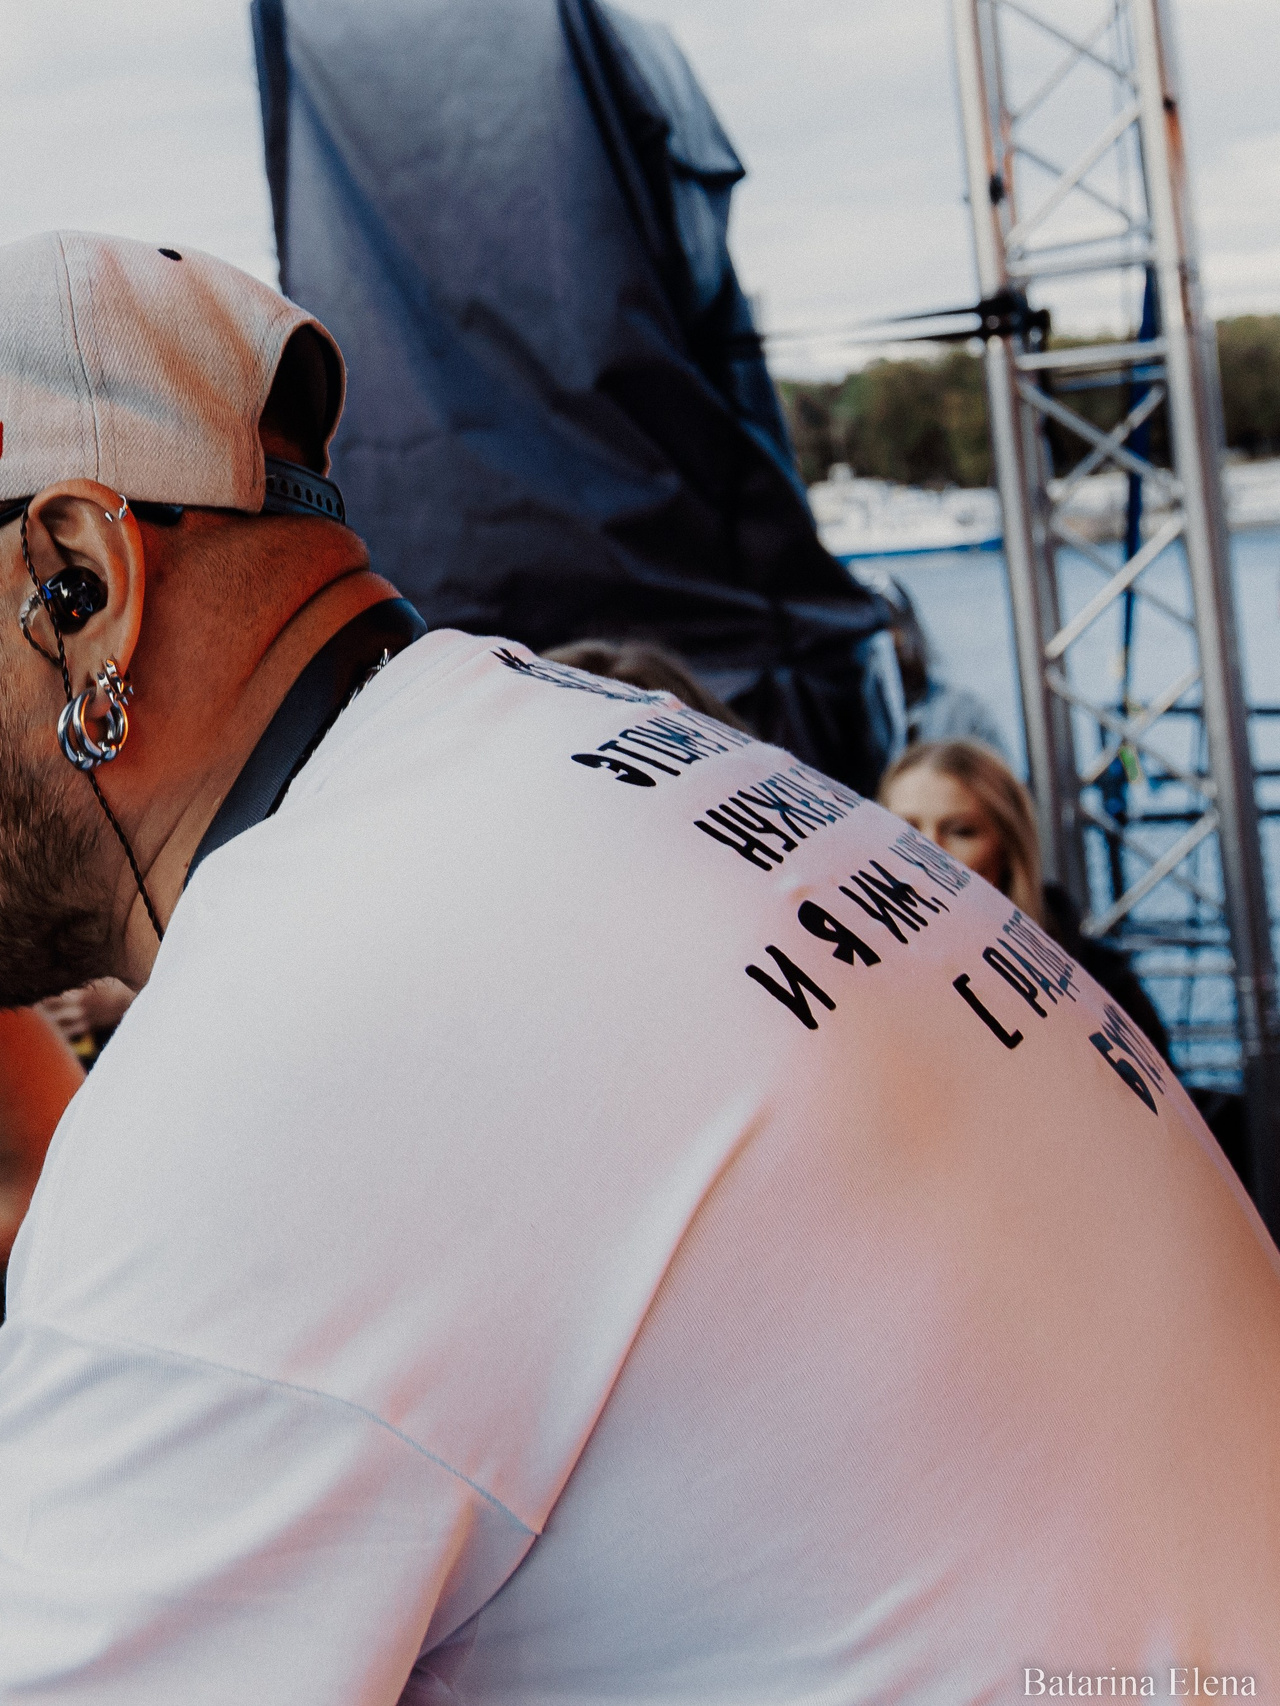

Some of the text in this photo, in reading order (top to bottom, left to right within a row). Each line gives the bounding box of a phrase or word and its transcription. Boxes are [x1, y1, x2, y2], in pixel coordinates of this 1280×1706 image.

[571, 716, 729, 787] ЭТОМУ
[745, 945, 837, 1030] И
[797, 900, 882, 966] Я
[952, 973, 1024, 1049] С
